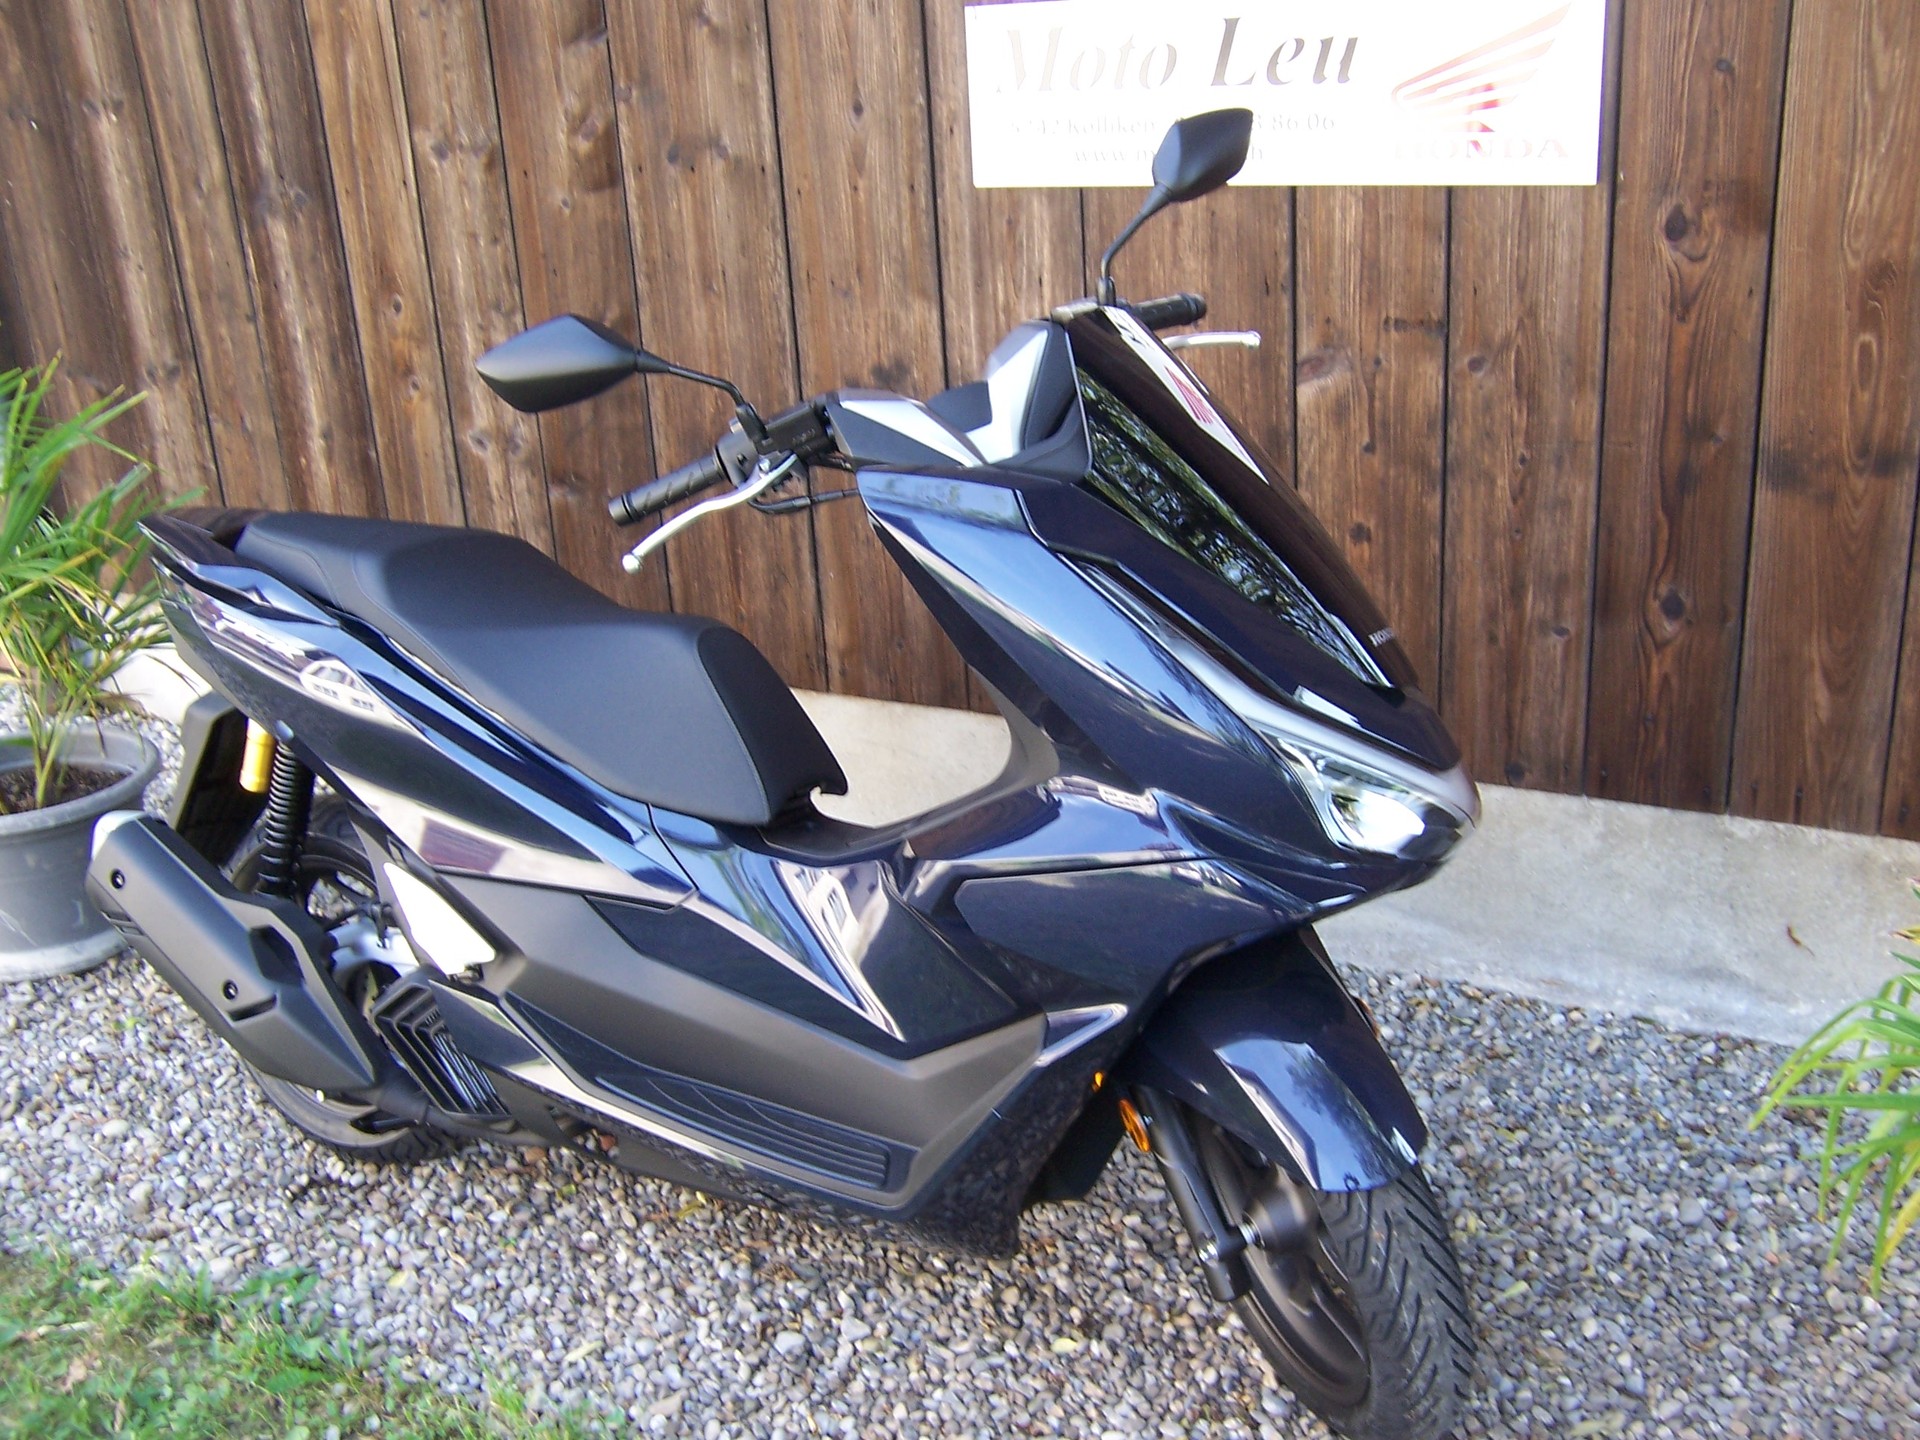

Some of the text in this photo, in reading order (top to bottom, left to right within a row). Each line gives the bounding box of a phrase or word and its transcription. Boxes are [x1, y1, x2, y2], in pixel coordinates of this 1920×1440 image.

[996, 15, 1360, 93] Moto Leu
[1394, 138, 1570, 160] HONDA
